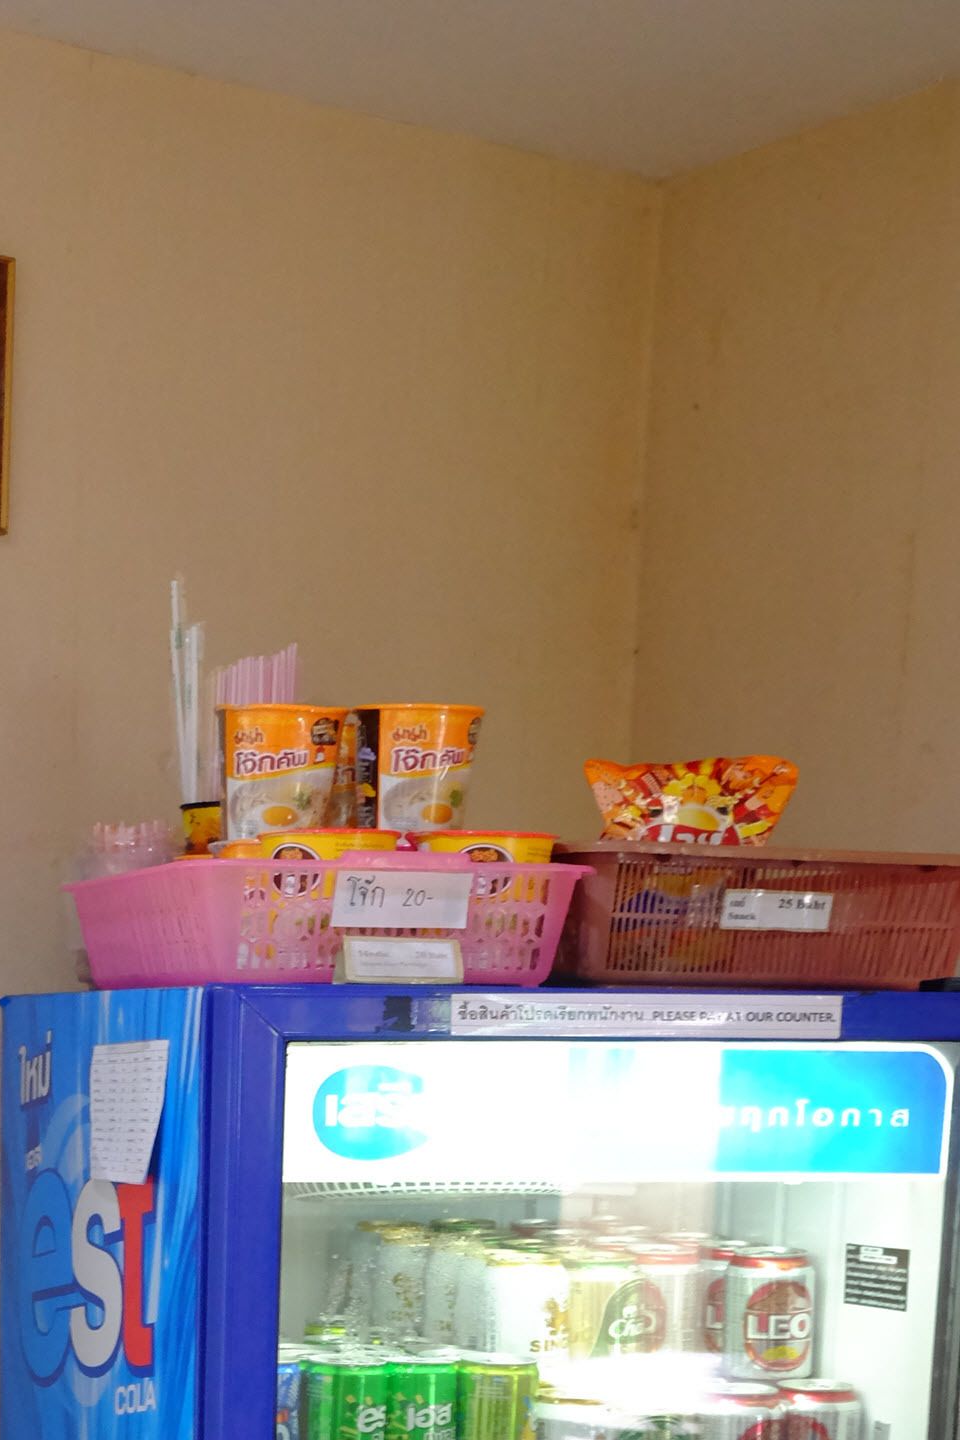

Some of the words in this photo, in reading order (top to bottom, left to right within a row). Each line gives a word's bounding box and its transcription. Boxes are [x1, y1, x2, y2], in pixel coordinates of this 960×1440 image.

[778, 898, 793, 909] 25
[796, 899, 826, 910] Baht
[652, 1011, 696, 1021] PLEASE
[746, 1011, 773, 1022] OUR
[747, 1313, 812, 1339] LEO
[113, 1376, 157, 1414] COLA
